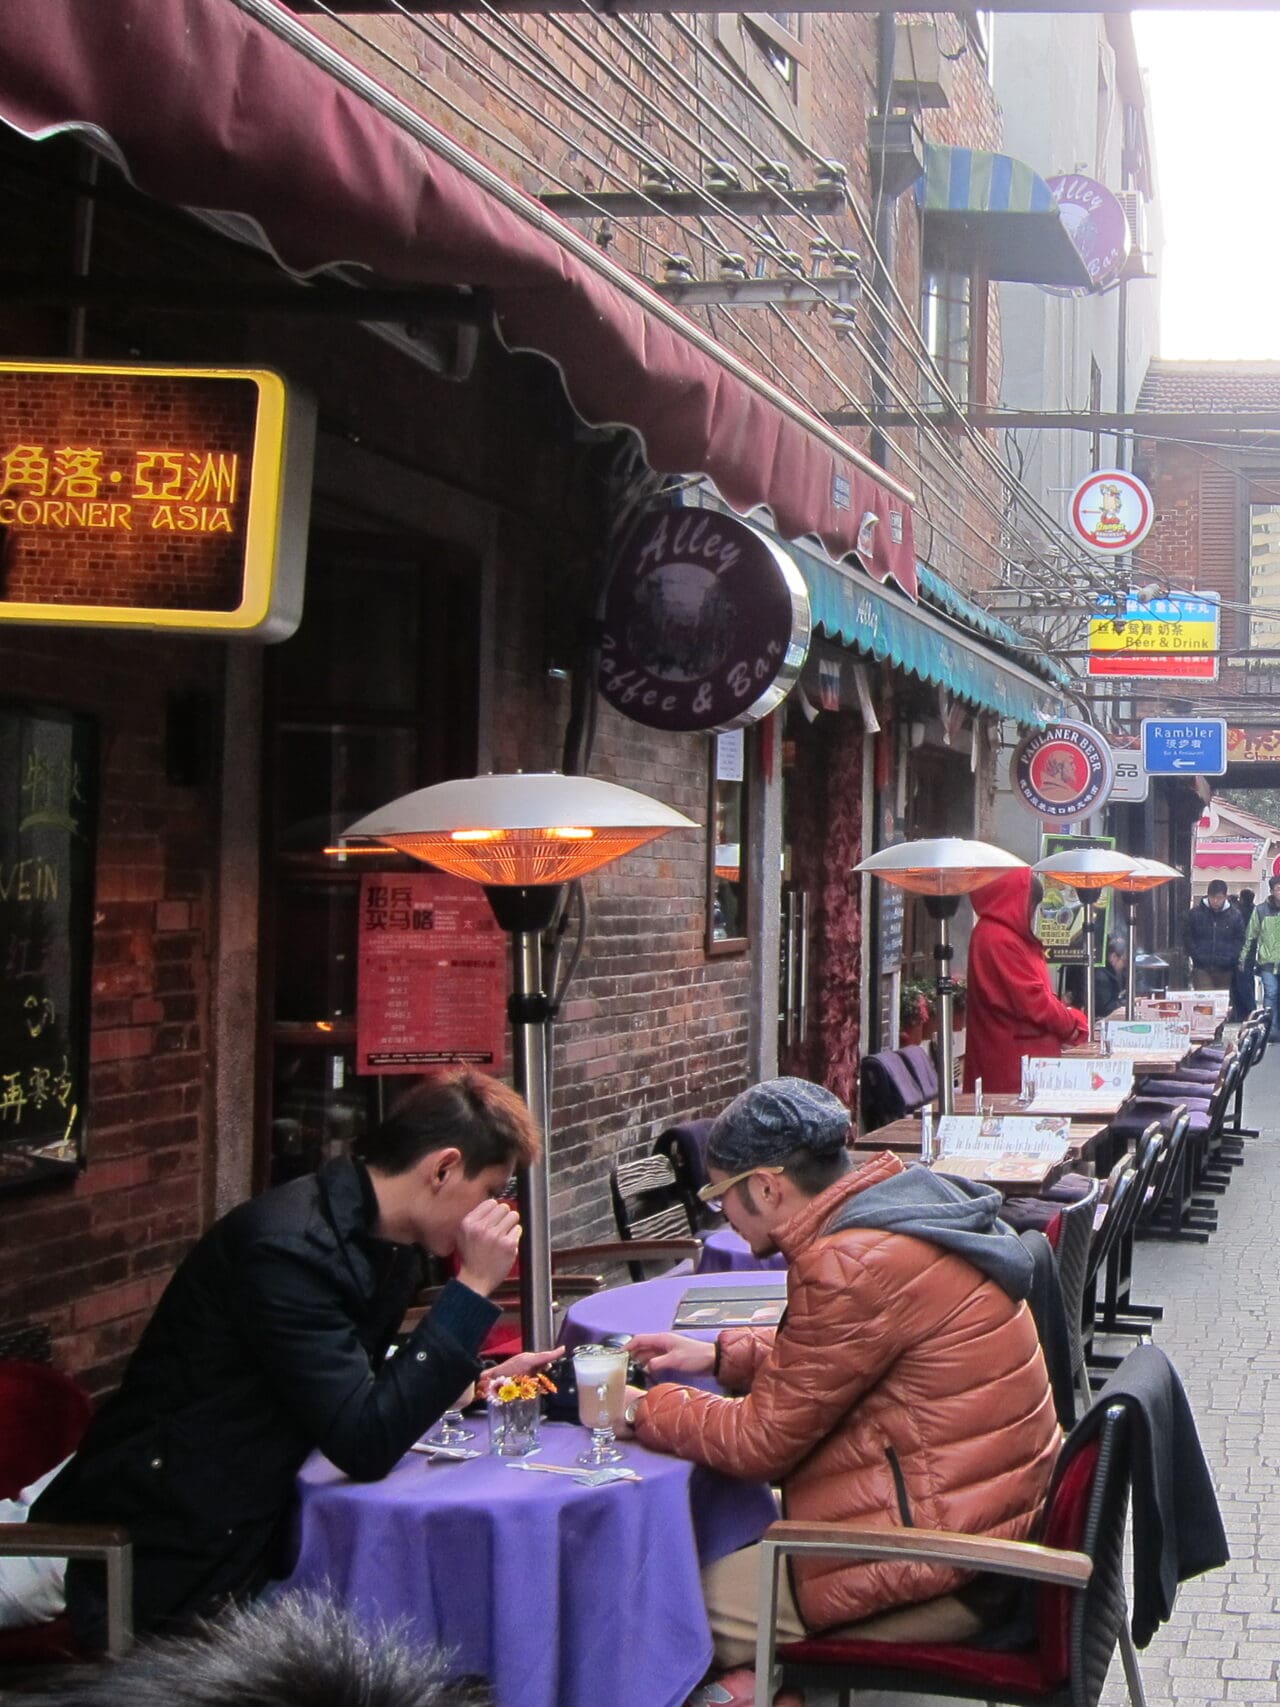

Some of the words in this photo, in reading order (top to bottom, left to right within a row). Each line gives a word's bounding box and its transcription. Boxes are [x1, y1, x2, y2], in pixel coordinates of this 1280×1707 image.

[1052, 177, 1103, 211] Alley
[1087, 248, 1119, 276] Bar
[0, 499, 132, 530] CORNER
[151, 505, 233, 532] ASIA
[636, 515, 741, 576] Alley
[1126, 636, 1155, 648] Beer
[1160, 637, 1168, 648] &
[1173, 637, 1208, 648] Drink
[691, 682, 712, 713] &
[727, 640, 781, 698] Bar
[1155, 727, 1214, 738] Rambler
[1021, 728, 1079, 764] PAULANER
[1080, 738, 1102, 772] BEER
